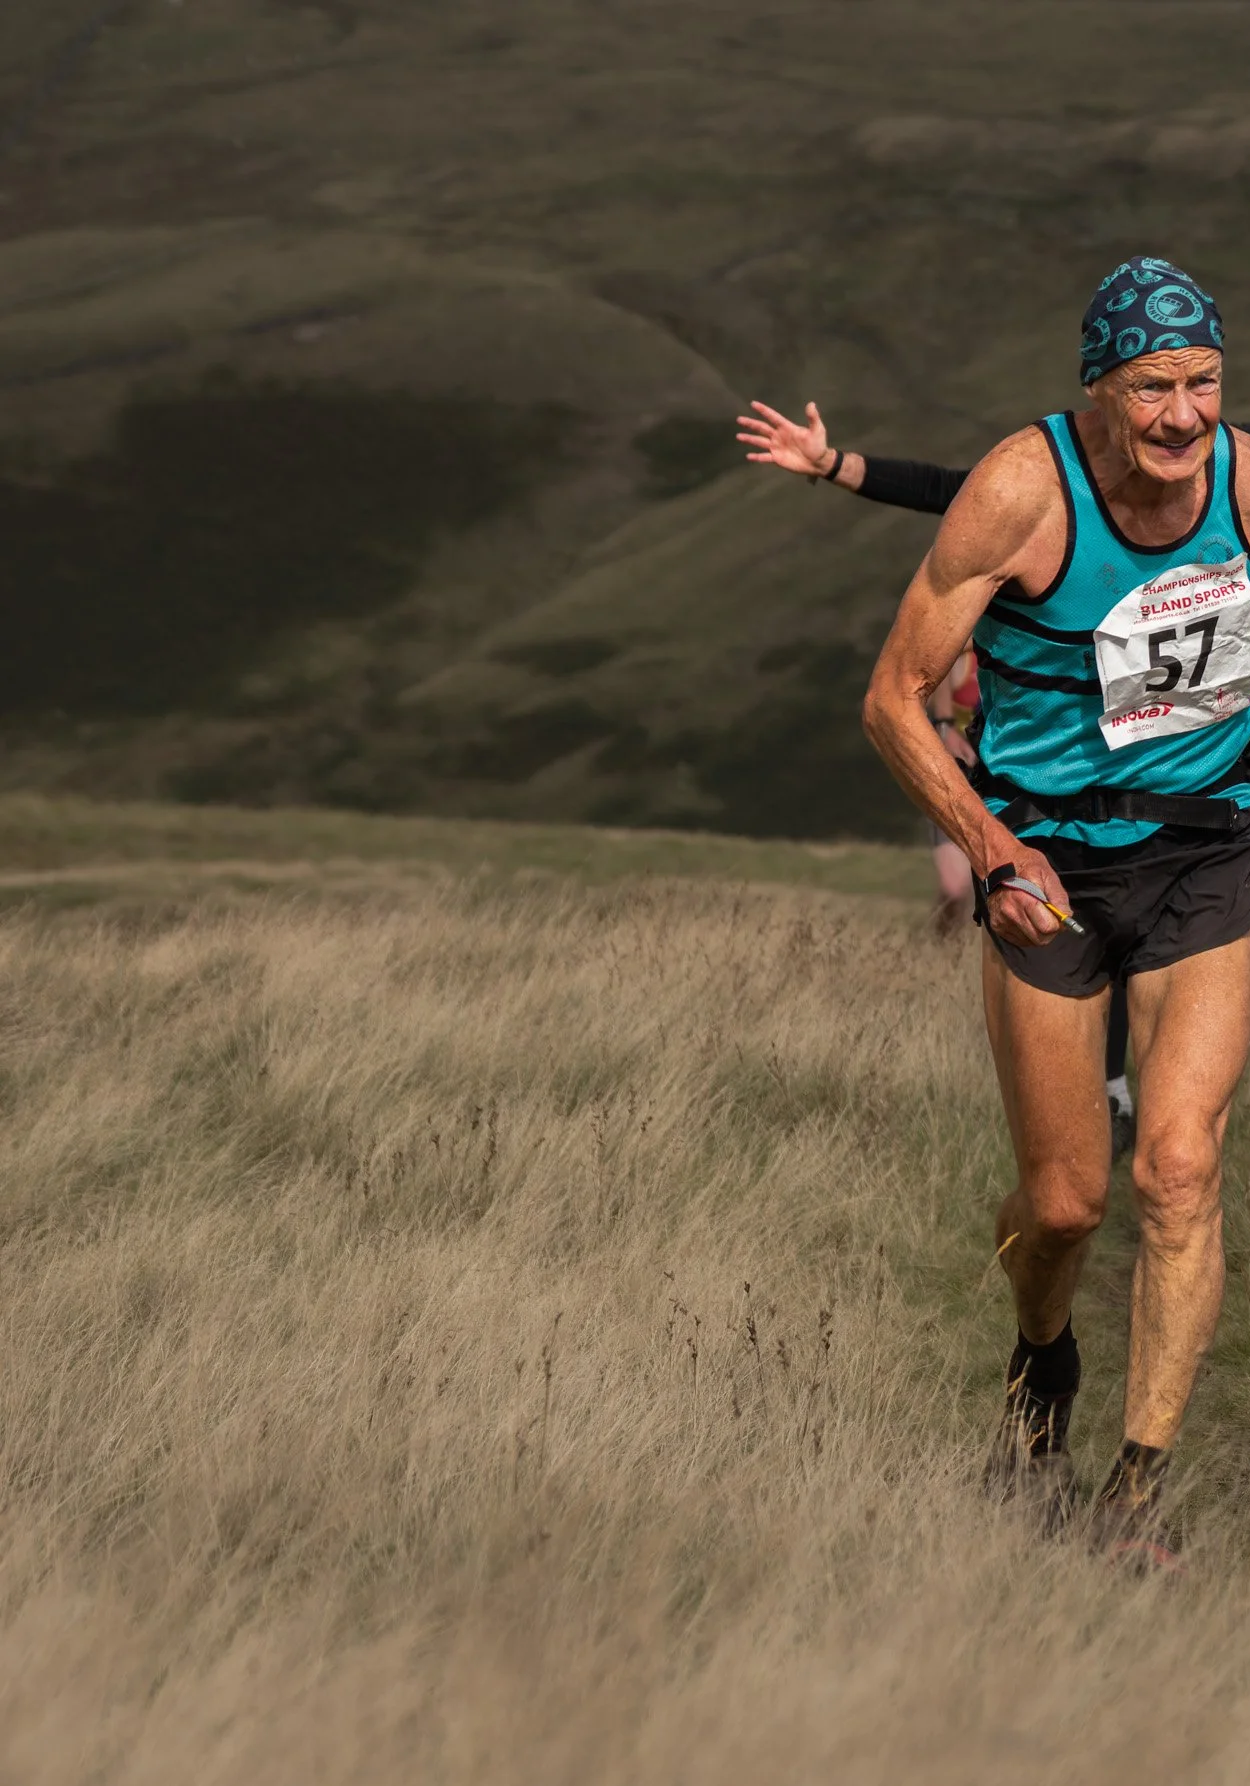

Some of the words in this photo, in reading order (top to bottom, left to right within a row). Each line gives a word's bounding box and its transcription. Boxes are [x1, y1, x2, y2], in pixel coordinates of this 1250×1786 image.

[1148, 295, 1169, 324] RUNNERS
[1142, 571, 1222, 596] CHAMPIONSHIPS
[1225, 563, 1244, 577] 2025
[1141, 597, 1192, 616] BLAND
[1194, 581, 1246, 604] SPORTS
[1145, 616, 1220, 692] 57
[1111, 707, 1161, 728] INOV8
